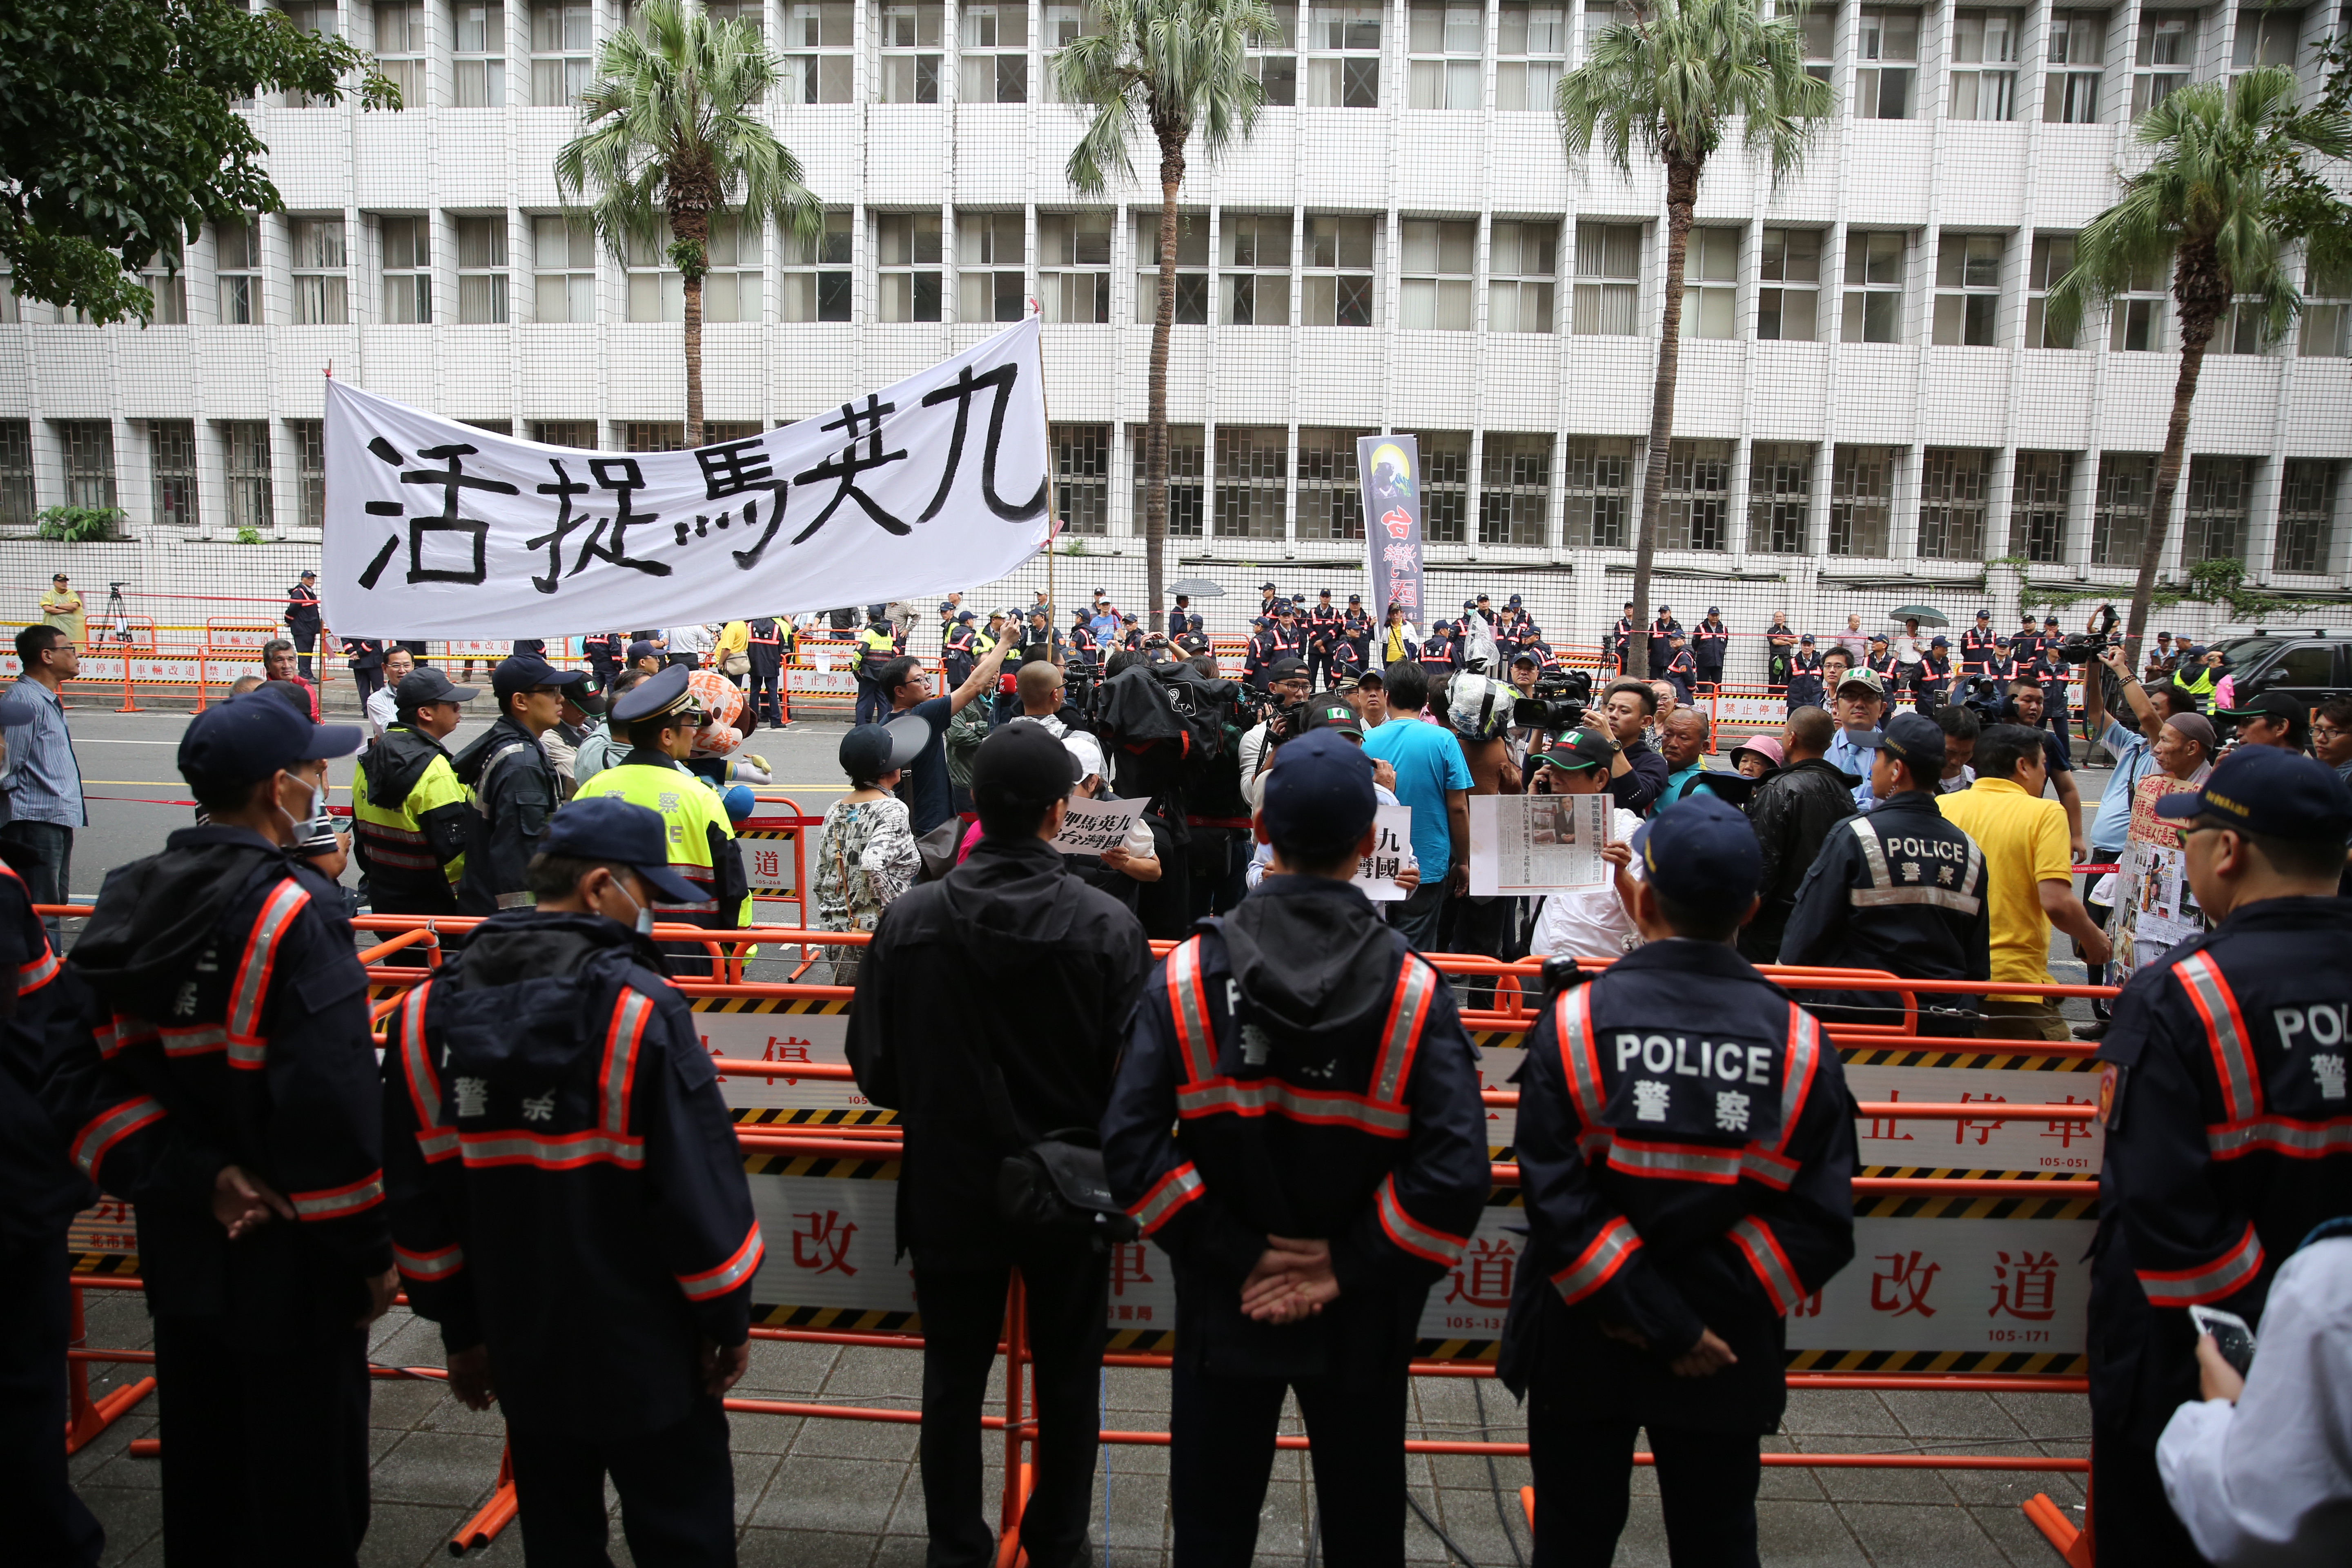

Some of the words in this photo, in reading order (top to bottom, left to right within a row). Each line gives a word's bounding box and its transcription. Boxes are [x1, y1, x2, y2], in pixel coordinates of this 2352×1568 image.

[358, 363, 1047, 594] 活捉馬英九
[456, 641, 509, 650] 車輛改道
[136, 664, 195, 676] 車輛改道
[793, 675, 854, 687] 禁止停車
[1724, 703, 1787, 716] 禁止停車
[1054, 829, 1125, 850] 台灣國
[1888, 837, 1964, 863] POLICE
[755, 851, 779, 877] 道
[1901, 862, 1954, 885] 警察
[1615, 1034, 1772, 1085] POLICE
[1633, 1080, 1750, 1132] 警察
[2040, 1157, 2088, 1168] 105-051
[792, 1209, 859, 1277] 改
[1444, 1238, 1516, 1309] 道
[1794, 1251, 2059, 1321] 改道
[1446, 1317, 1506, 1329] 105-13
[1989, 1330, 2049, 1342] 105-171
